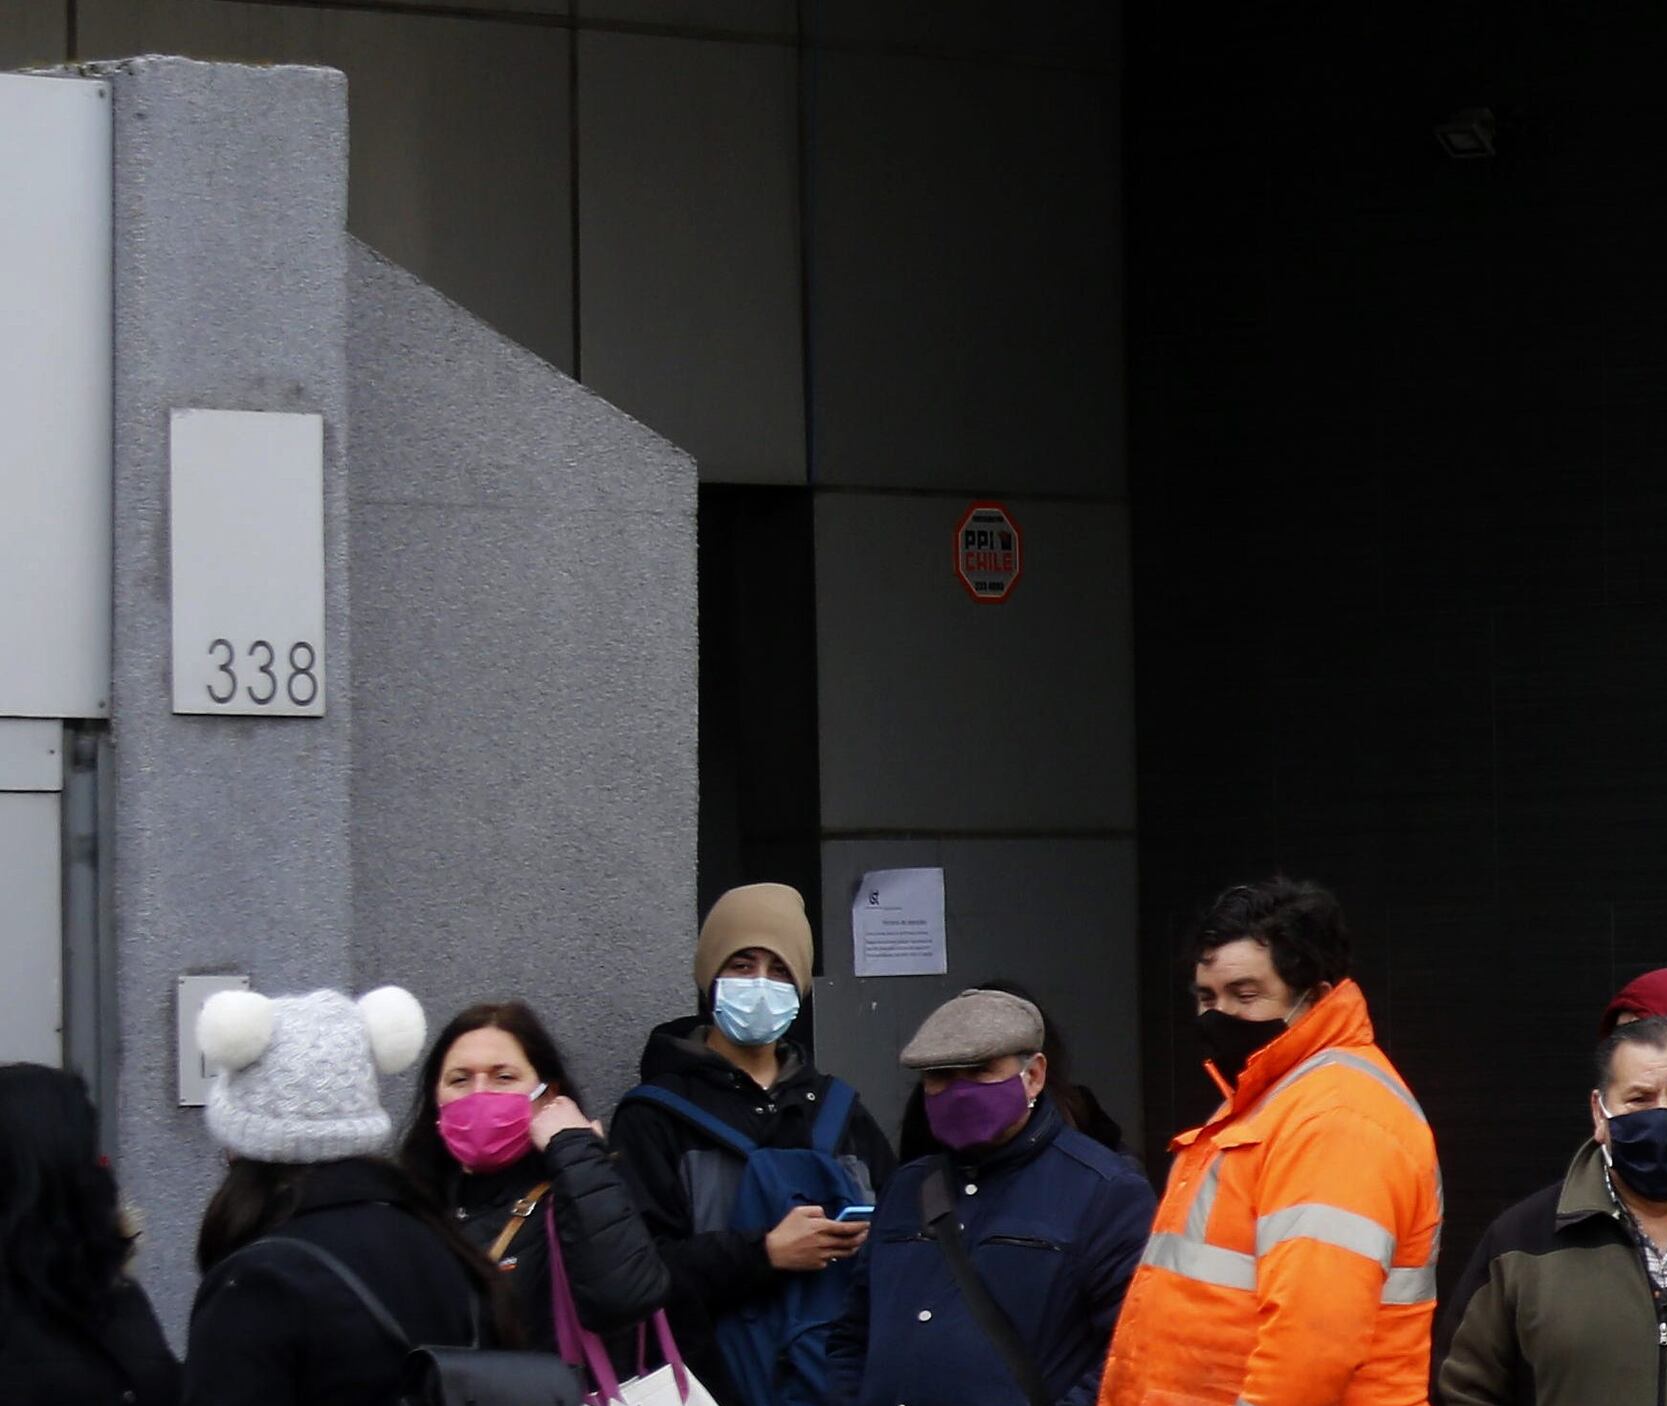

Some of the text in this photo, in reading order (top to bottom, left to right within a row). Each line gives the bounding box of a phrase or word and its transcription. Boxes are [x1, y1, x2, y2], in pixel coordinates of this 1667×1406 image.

[965, 530, 994, 550] PPI
[966, 551, 1012, 572] CHILE
[205, 638, 319, 707] 338
